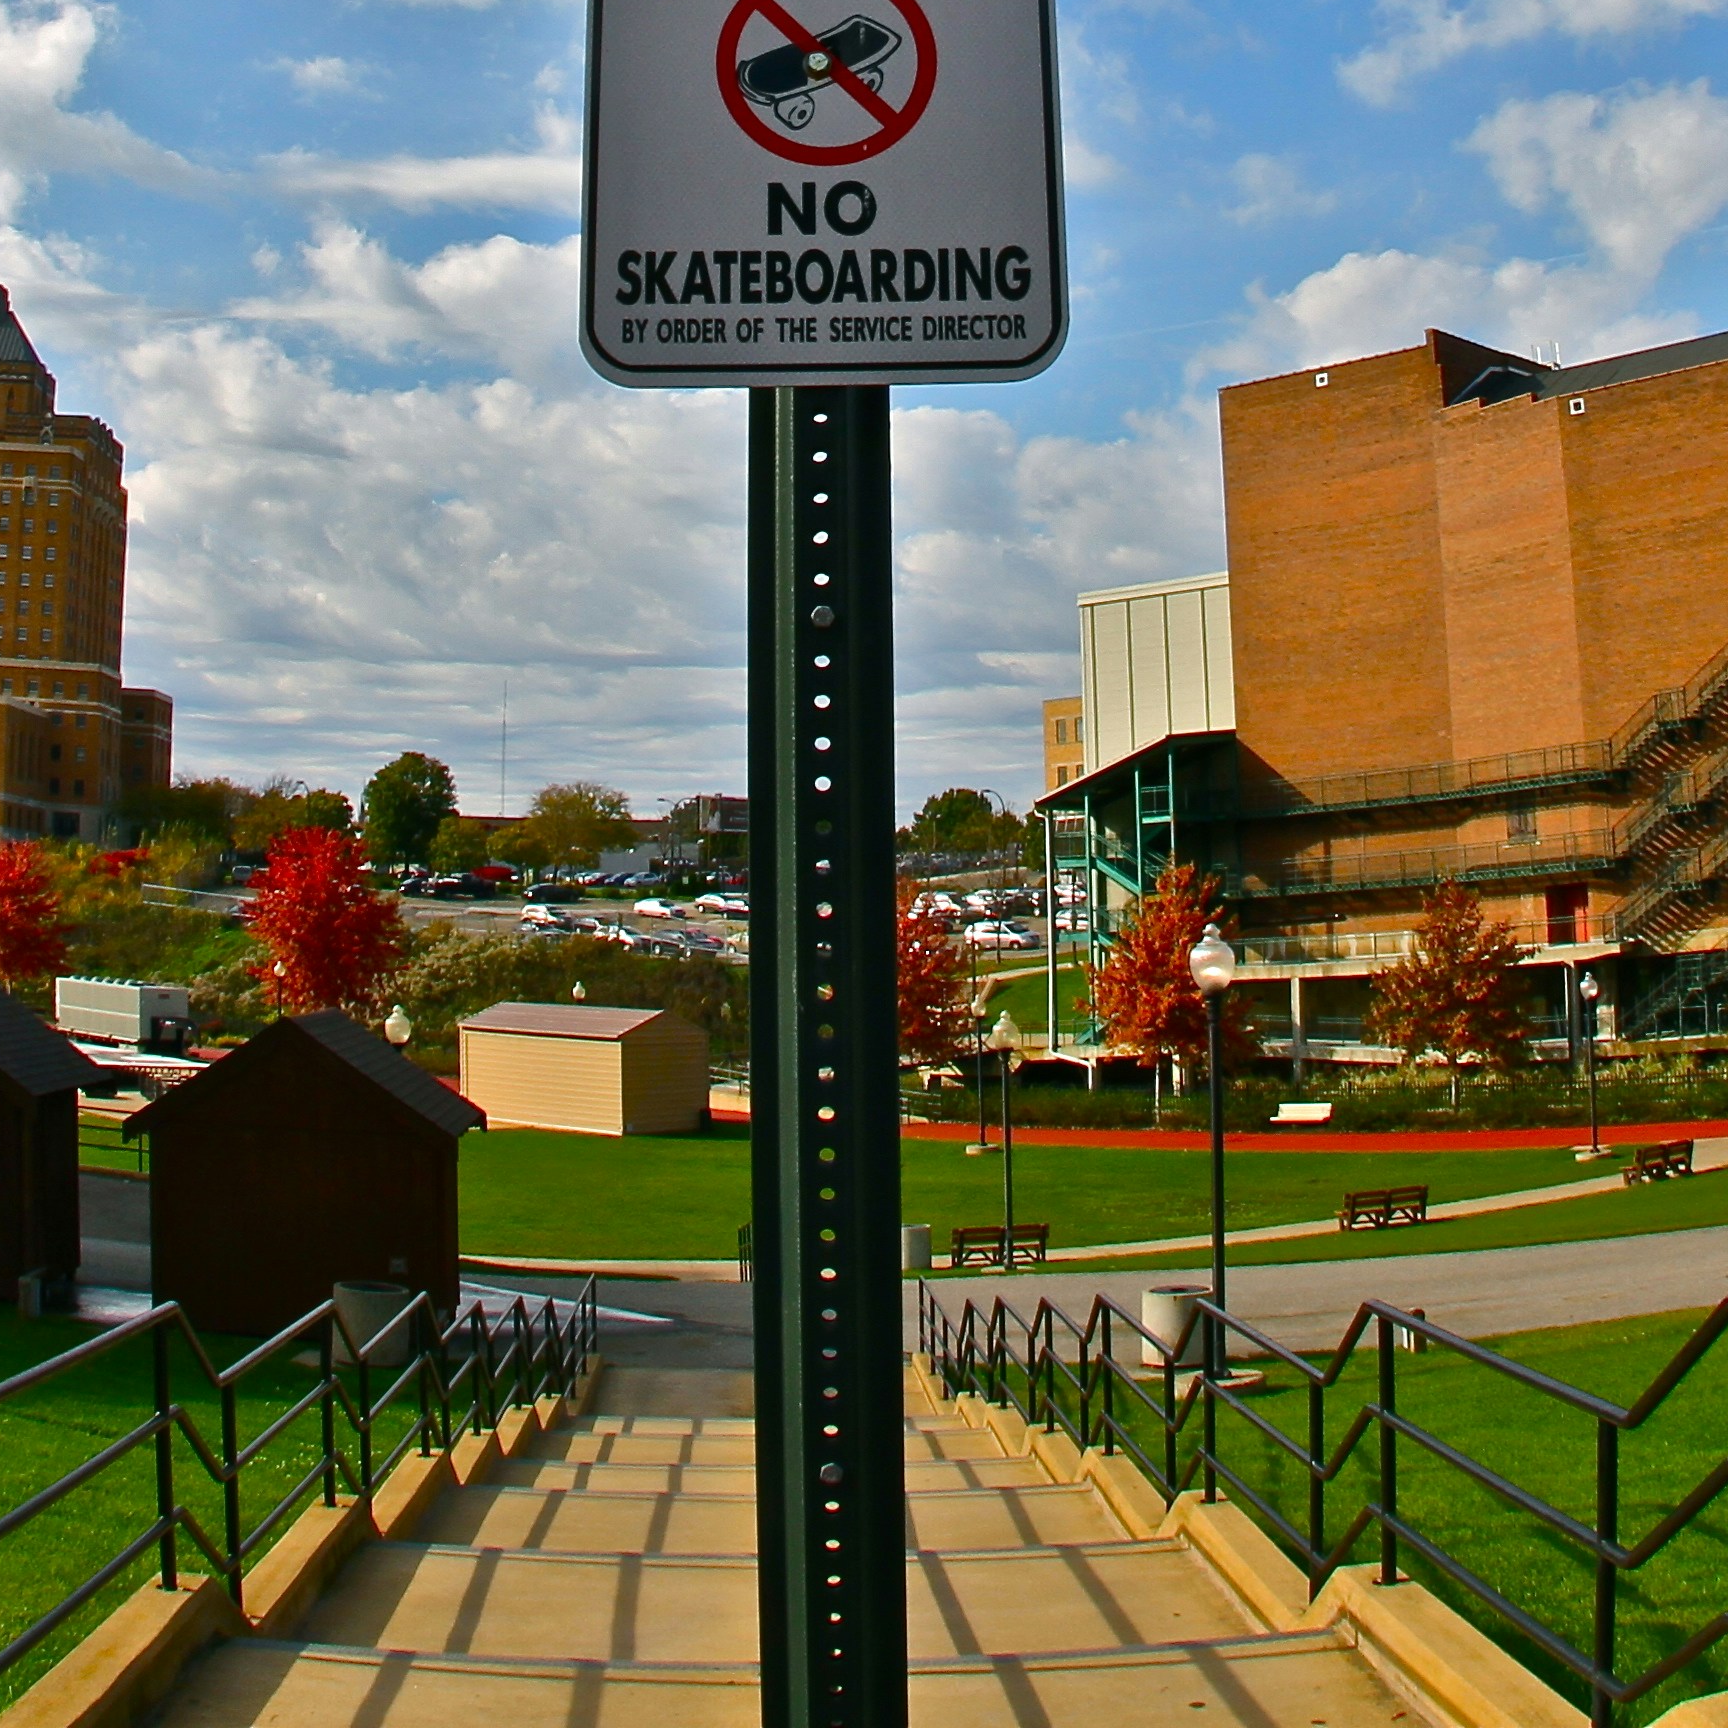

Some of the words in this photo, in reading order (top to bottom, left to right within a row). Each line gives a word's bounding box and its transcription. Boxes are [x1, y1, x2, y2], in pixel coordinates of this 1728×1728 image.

[767, 181, 877, 235] NO
[615, 246, 1031, 305] SKATEBOARDING
[622, 320, 647, 343] BY
[657, 318, 726, 343] ORDER
[736, 318, 764, 343] OF
[775, 317, 817, 342] THE
[830, 316, 912, 342] SERVICE
[923, 315, 1026, 340] DIRECTOR
